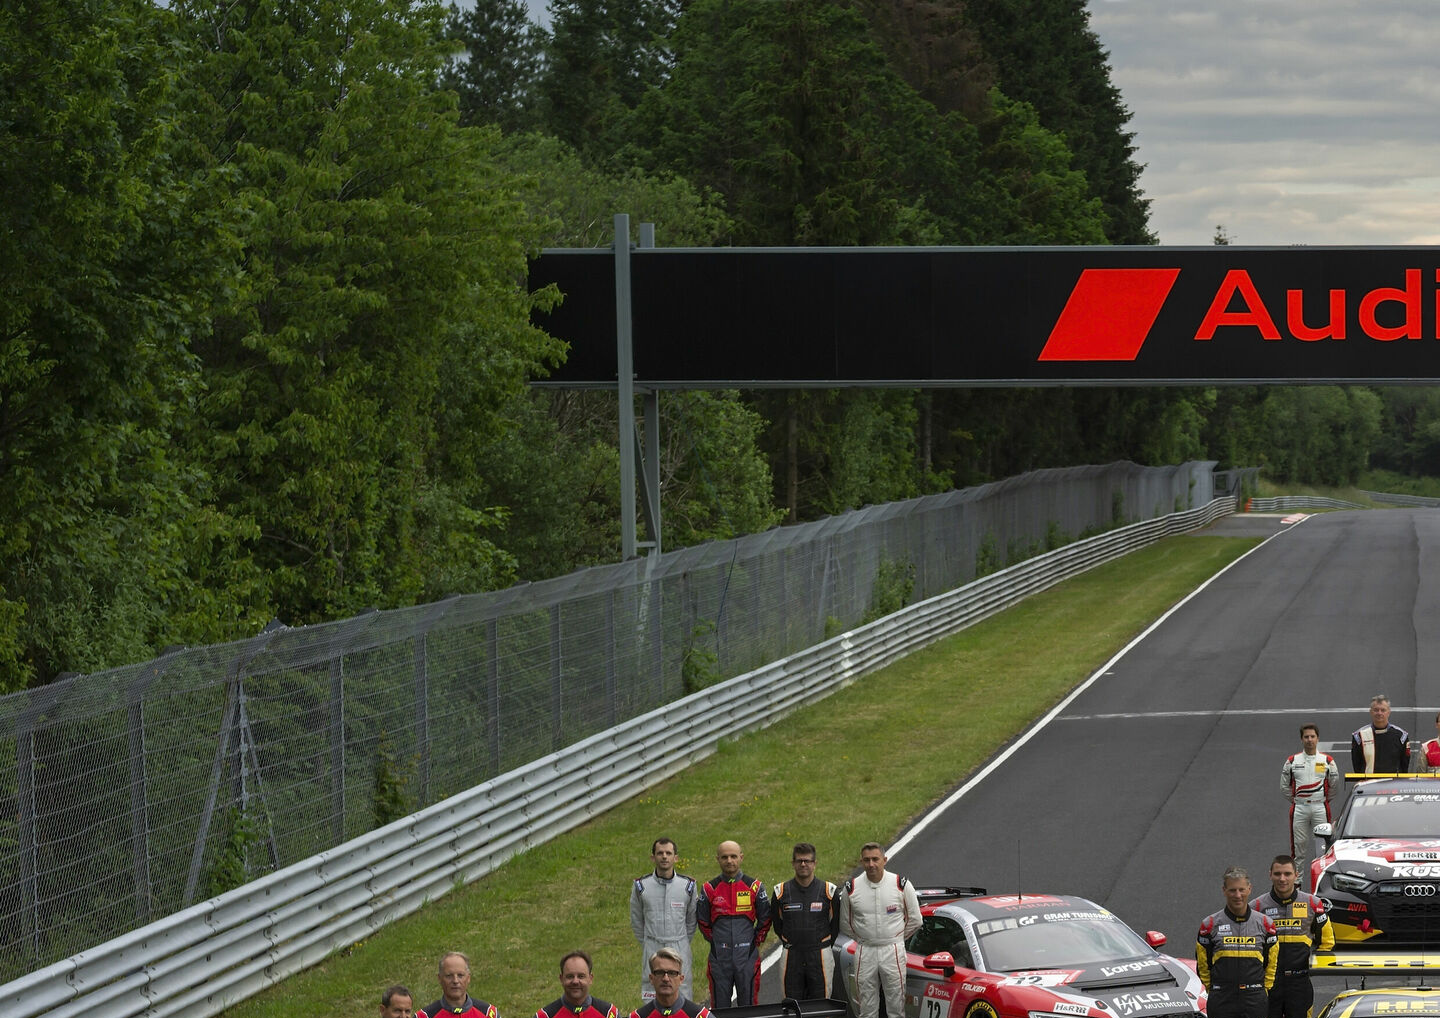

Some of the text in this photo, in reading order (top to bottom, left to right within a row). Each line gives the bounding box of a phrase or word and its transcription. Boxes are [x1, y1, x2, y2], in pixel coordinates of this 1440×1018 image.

[1005, 901, 1071, 912] HARMAN
[1347, 904, 1367, 912] AVIA
[1100, 959, 1160, 978] L'argus
[1013, 975, 1043, 986] 72
[934, 988, 950, 998] TOTAL
[961, 983, 986, 993] FALKEN
[1143, 1000, 1190, 1011] MULTIMEDIA
